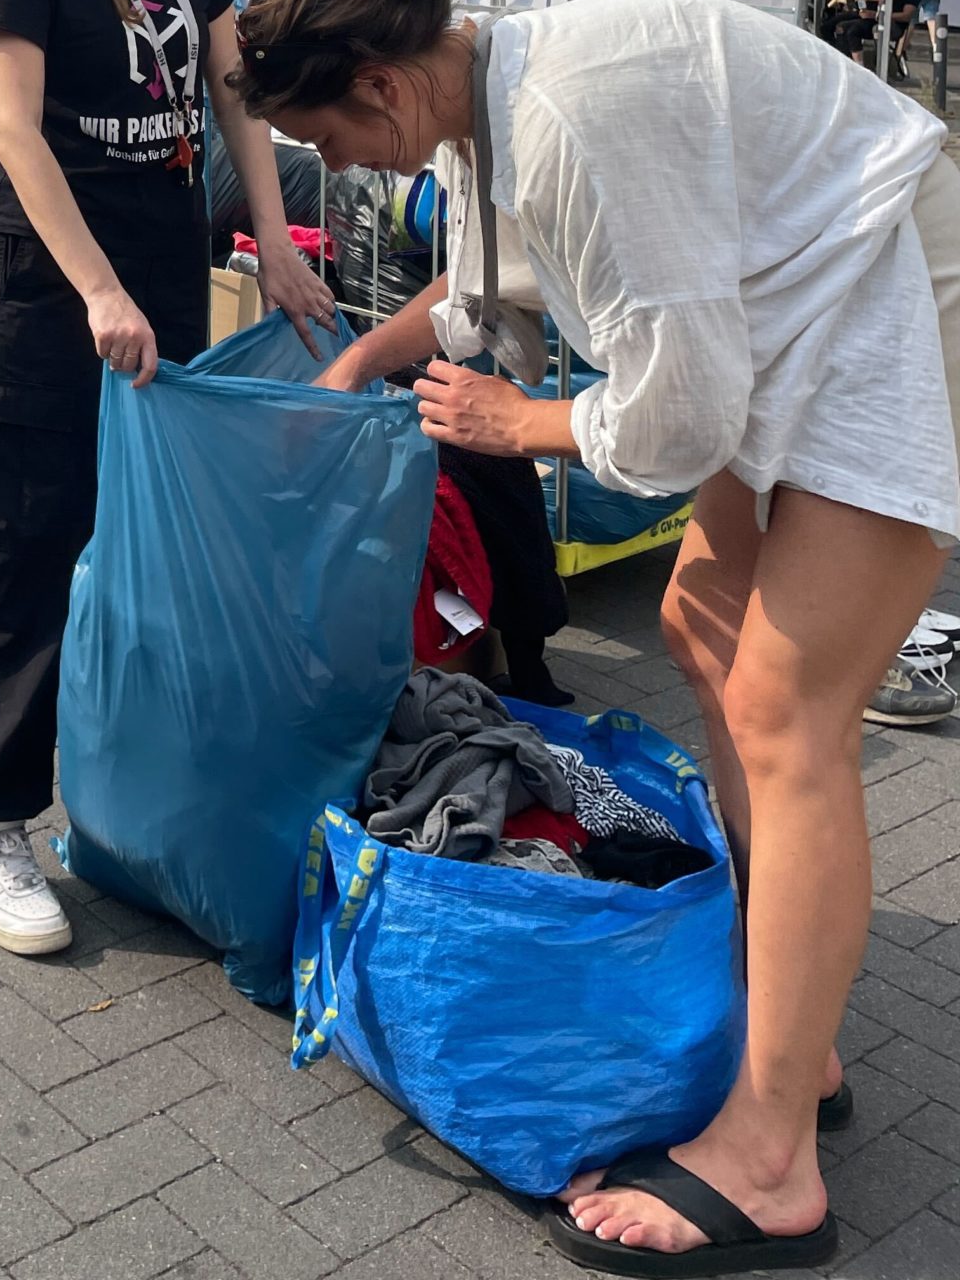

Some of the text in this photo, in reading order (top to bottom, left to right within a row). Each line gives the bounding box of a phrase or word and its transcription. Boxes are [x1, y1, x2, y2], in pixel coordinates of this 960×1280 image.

[156, 49, 166, 67] ISH
[190, 43, 198, 61] ISH
[79, 116, 120, 144] WIR
[106, 145, 148, 163] Nothilfe
[148, 149, 160, 161] für
